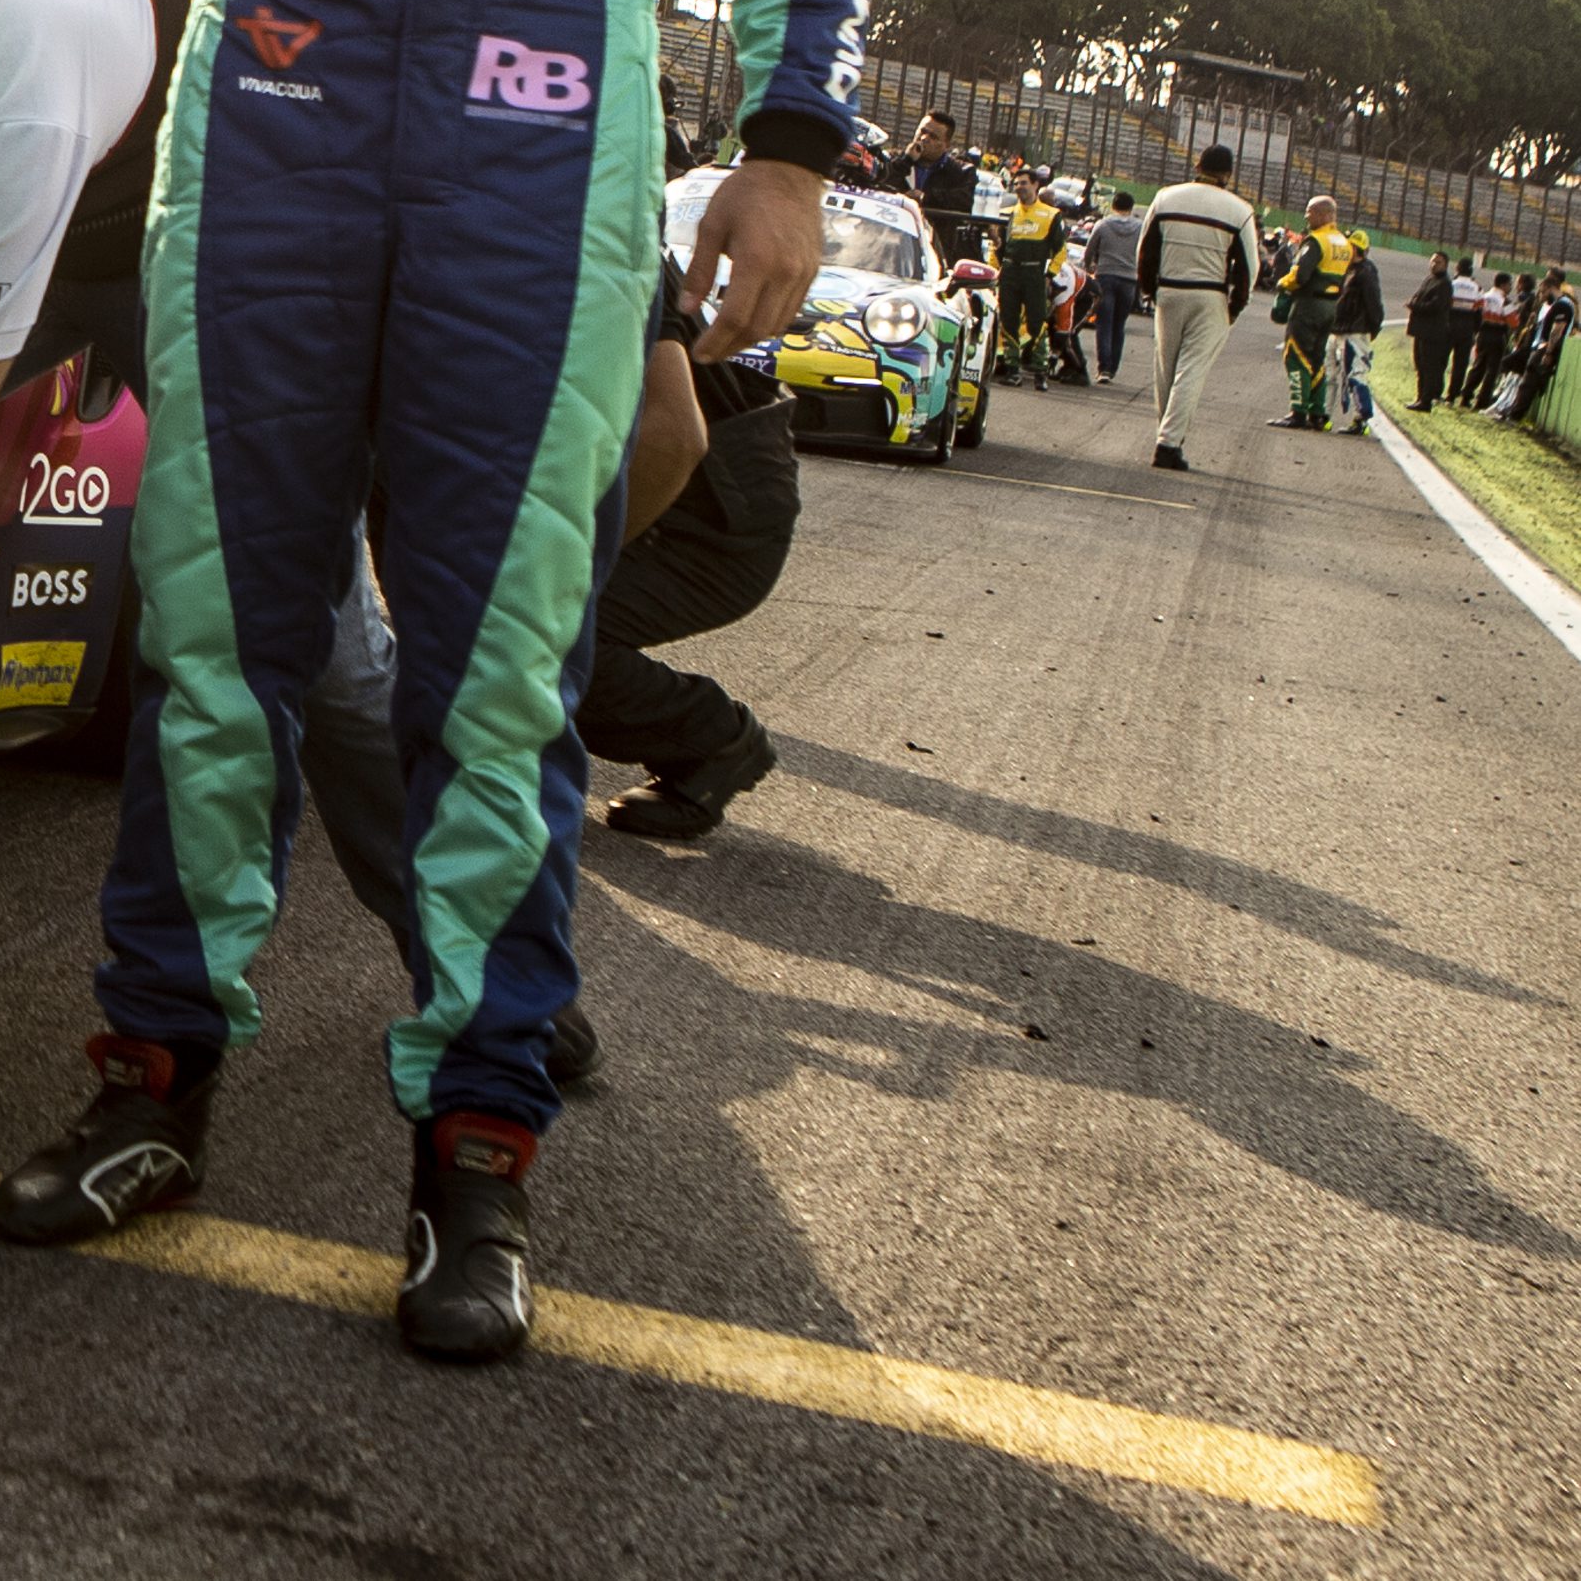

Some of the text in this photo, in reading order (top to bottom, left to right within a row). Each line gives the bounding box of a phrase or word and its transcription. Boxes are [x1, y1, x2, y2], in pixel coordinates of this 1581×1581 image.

[238, 75, 323, 102] VIVACQUA
[467, 34, 593, 112] RB
[12, 569, 88, 608] BOSS
